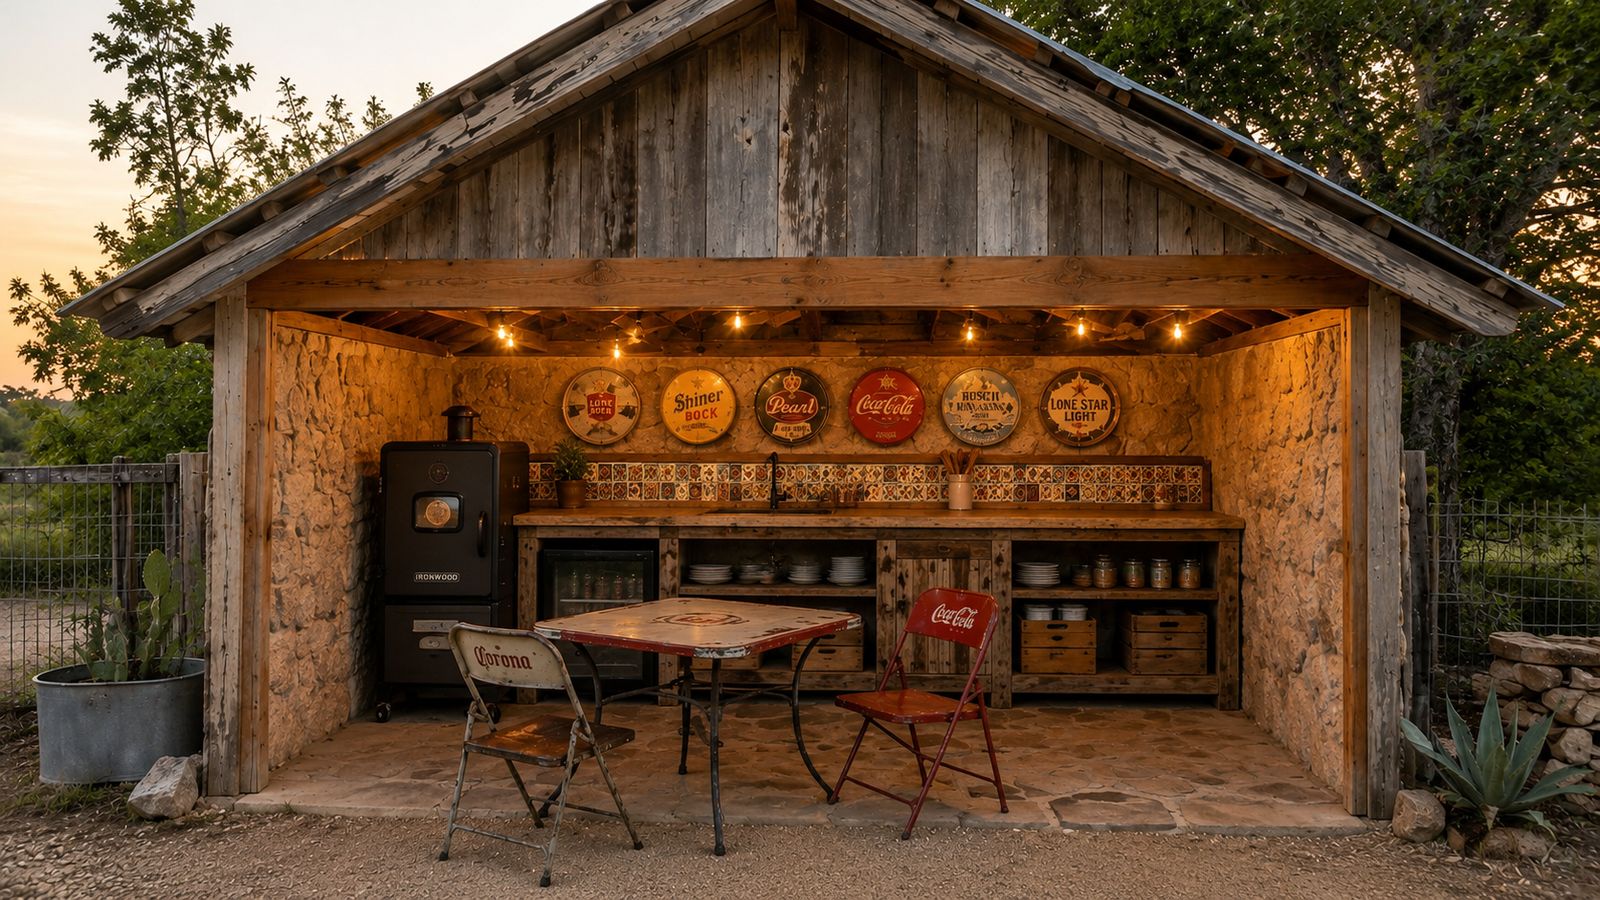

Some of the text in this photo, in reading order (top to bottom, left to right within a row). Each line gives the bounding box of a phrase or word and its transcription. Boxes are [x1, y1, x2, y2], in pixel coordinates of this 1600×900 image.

[674, 390, 724, 413] Shiner
[767, 395, 815, 414] Pearl
[1051, 398, 1109, 411] LONE STAR
[685, 407, 718, 421] BOCK
[1064, 411, 1097, 422] LIGHT
[415, 573, 458, 581] IRONWOOD
[474, 645, 533, 671] Corona
